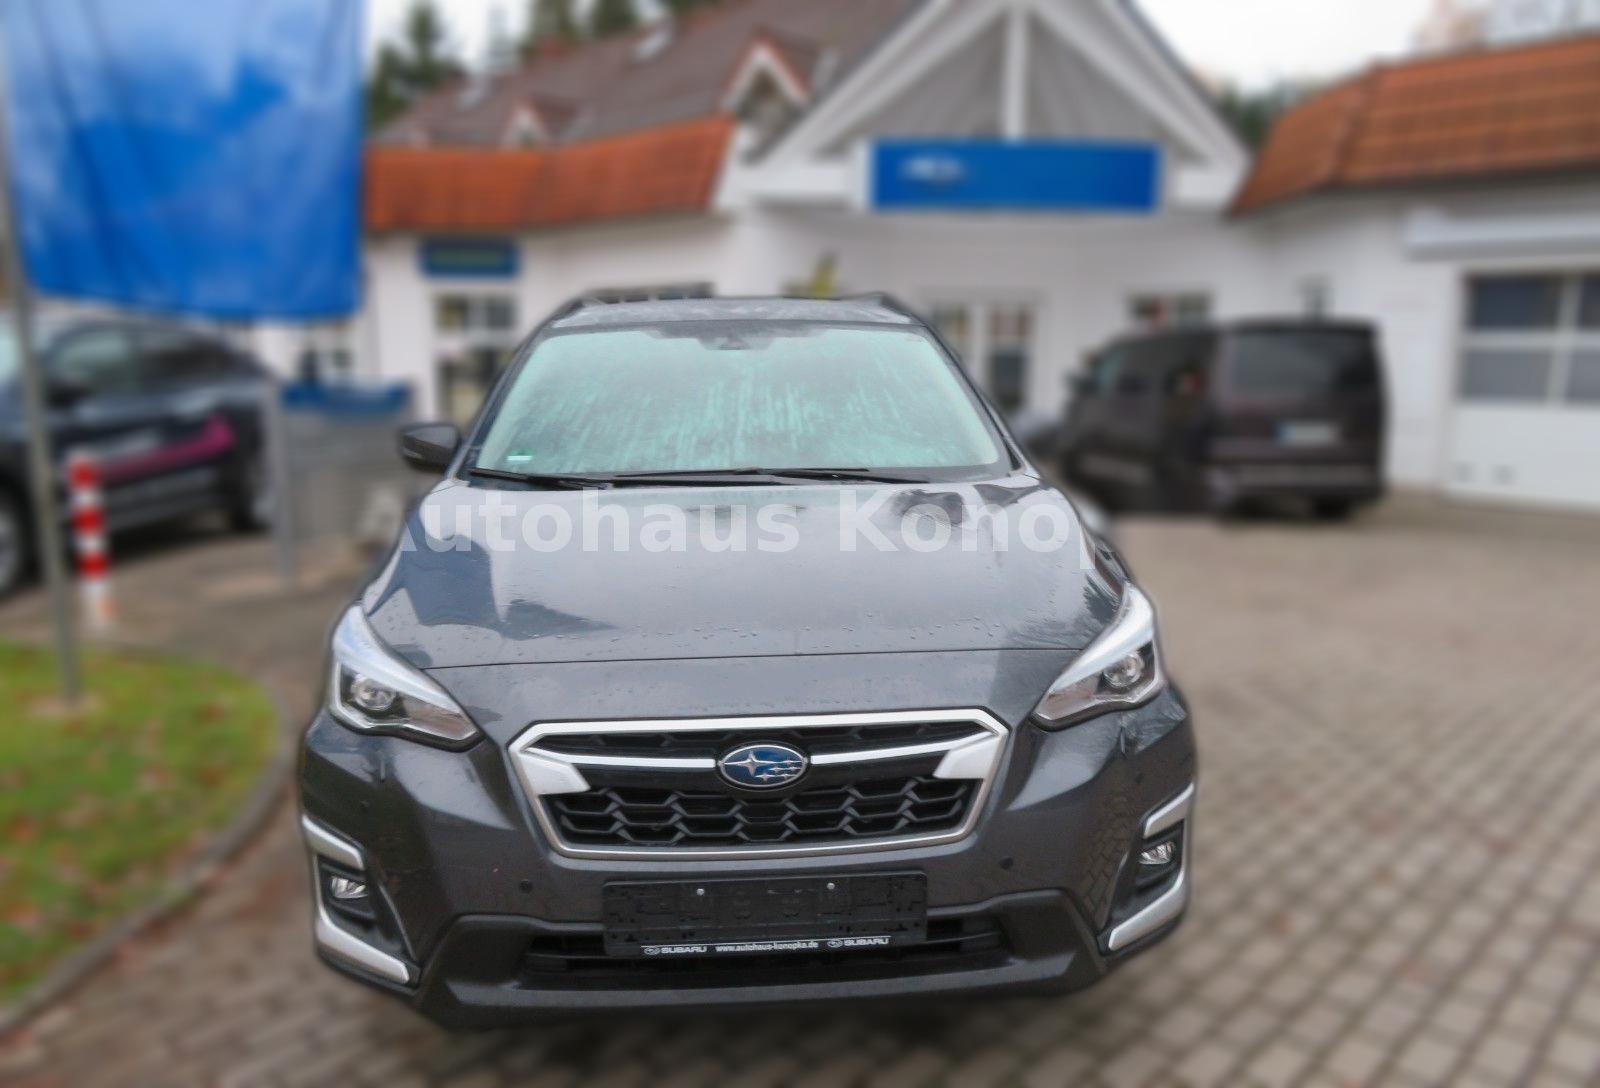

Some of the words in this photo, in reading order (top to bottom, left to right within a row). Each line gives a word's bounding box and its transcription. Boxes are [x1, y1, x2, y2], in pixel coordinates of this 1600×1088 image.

[660, 945, 707, 954] SUBARU
[715, 941, 819, 952] www.autohaus-konopka.de
[844, 937, 889, 947] SUBARU
